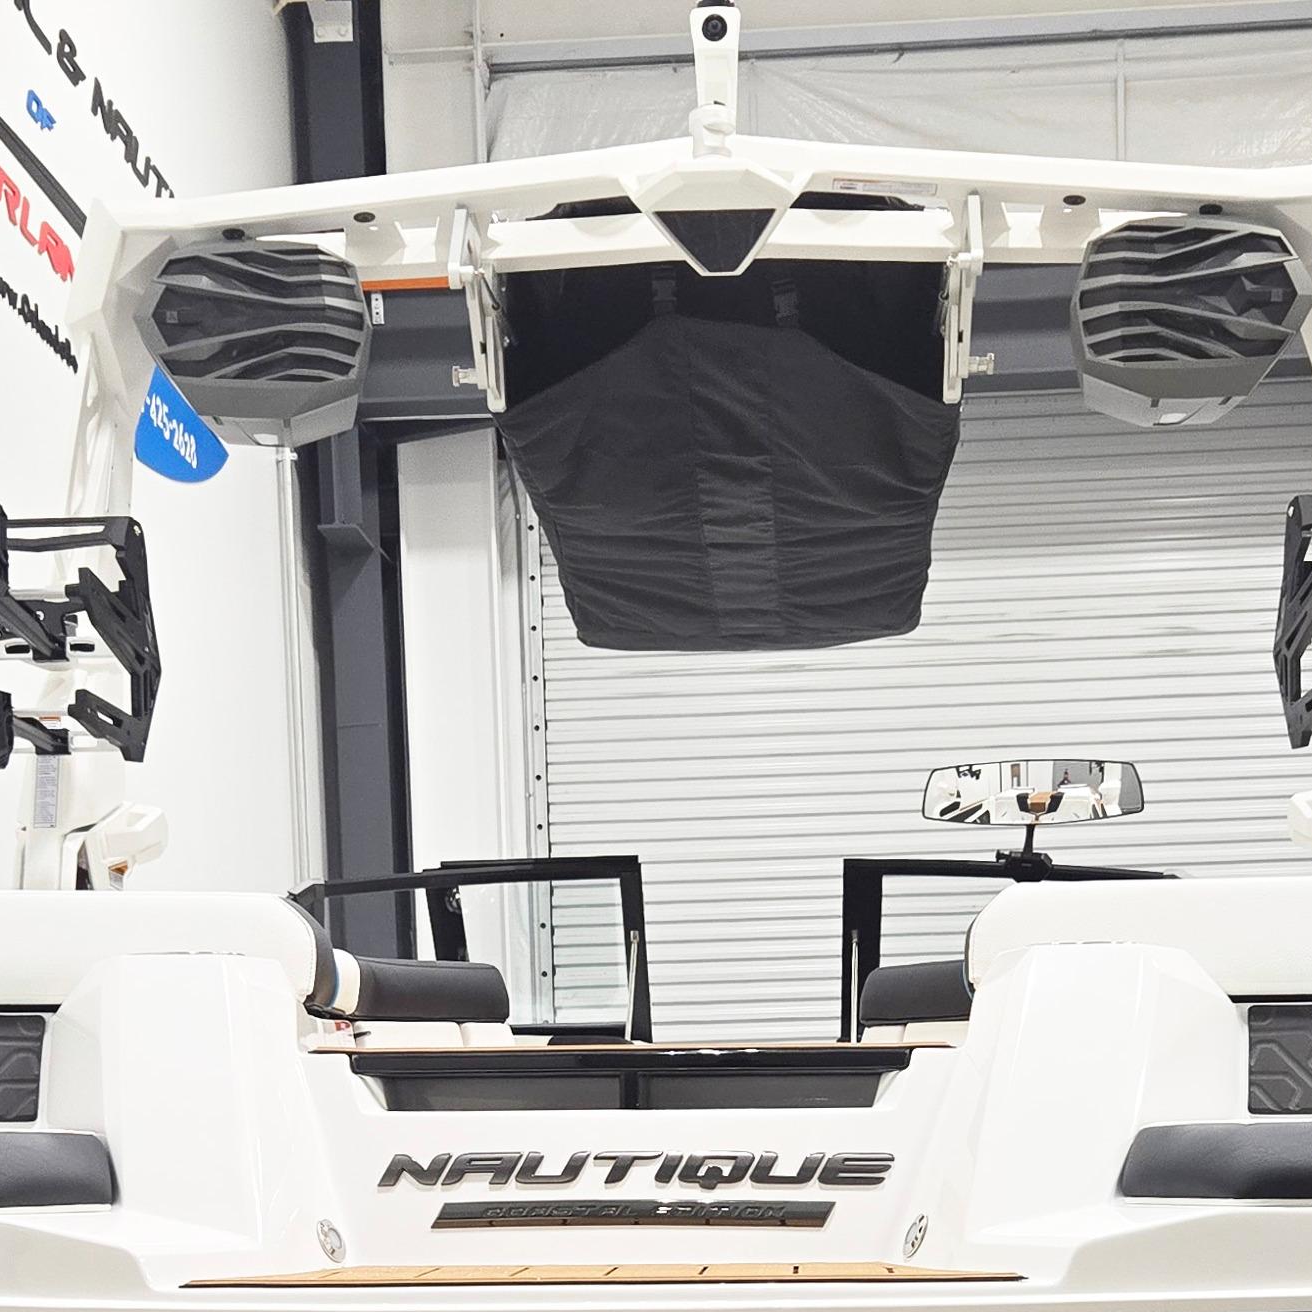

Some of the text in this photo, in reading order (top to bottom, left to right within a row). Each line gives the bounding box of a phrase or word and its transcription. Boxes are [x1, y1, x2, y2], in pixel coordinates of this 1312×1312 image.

[26, 89, 57, 131] OF
[56, 28, 86, 87] &
[91, 76, 175, 199] NAUT
[377, 1150, 896, 1190] NAUTIQUE
